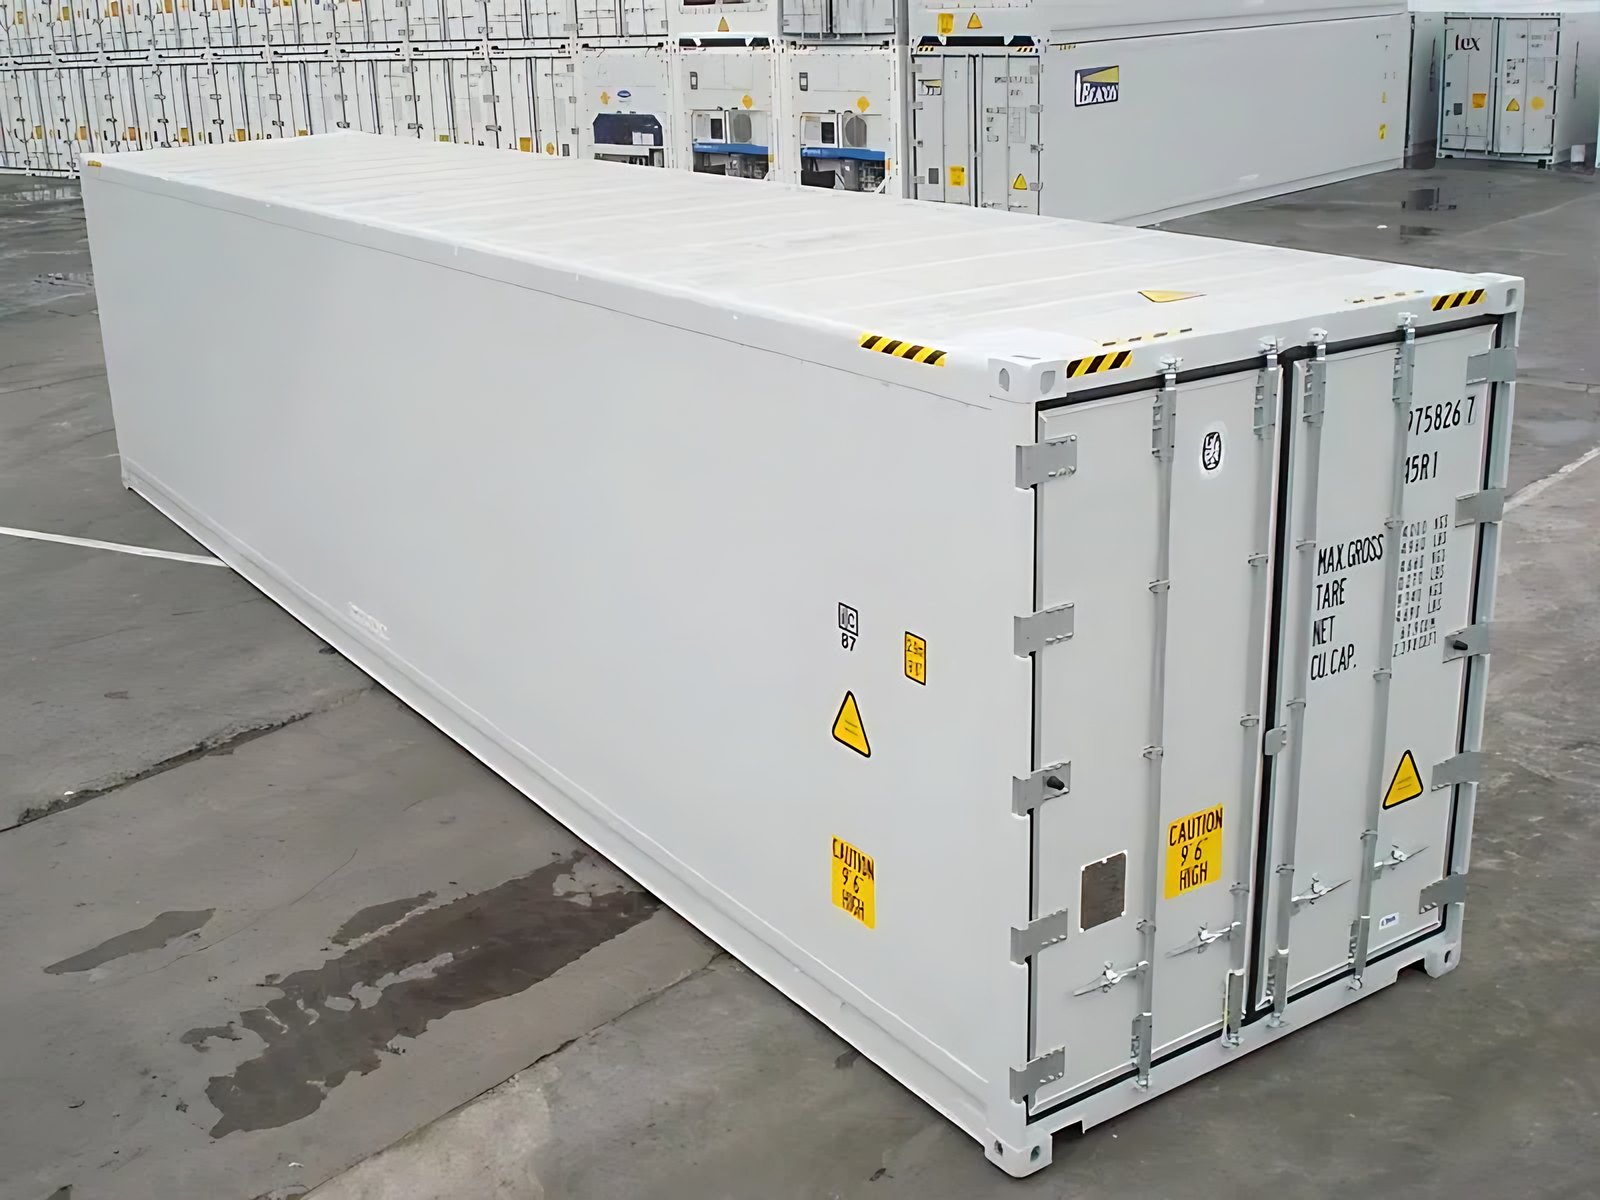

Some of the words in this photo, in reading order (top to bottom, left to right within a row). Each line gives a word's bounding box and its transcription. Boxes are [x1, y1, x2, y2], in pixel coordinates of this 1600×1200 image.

[1317, 577, 1347, 611] TARE
[841, 632, 856, 651] 87
[1312, 615, 1336, 647] NET
[1169, 807, 1223, 846] CAUTION
[1179, 861, 1208, 891] HIGH
